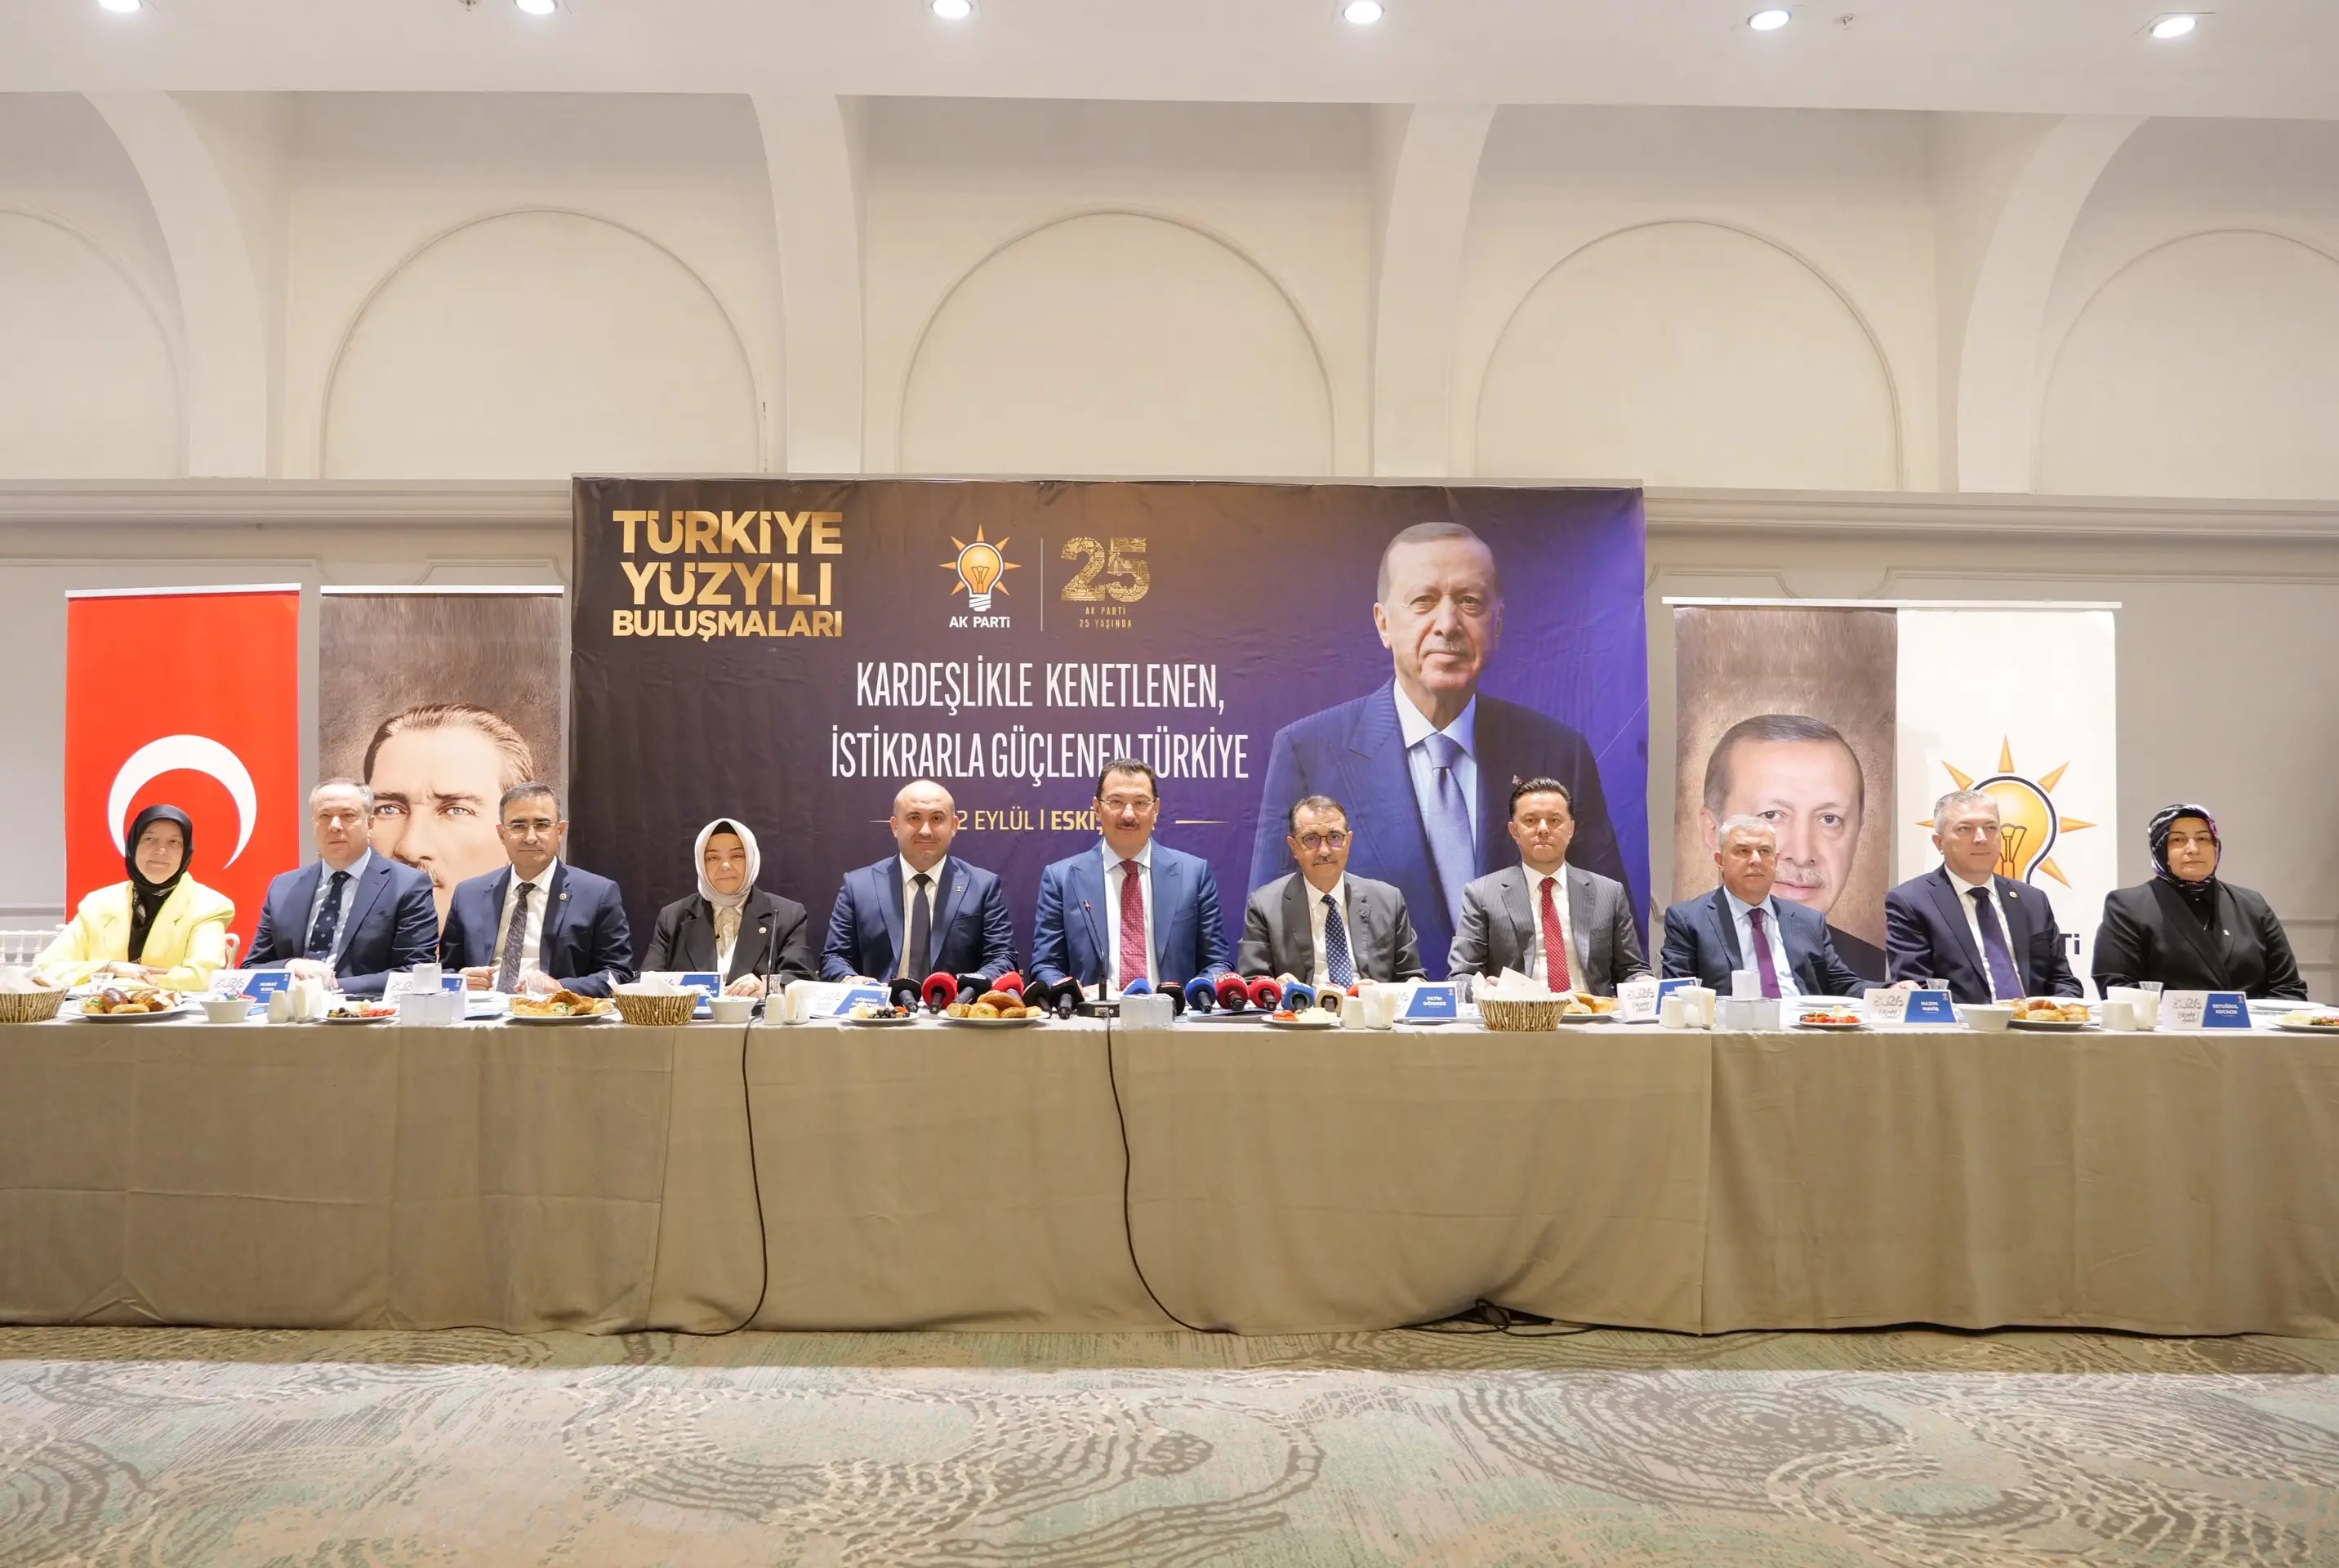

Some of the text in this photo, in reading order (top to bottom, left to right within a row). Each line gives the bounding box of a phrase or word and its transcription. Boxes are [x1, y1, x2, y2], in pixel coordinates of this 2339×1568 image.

[613, 510, 842, 555] TÜRKİYE
[620, 562, 831, 606] YÜZYILI
[1060, 537, 1151, 603] 25
[613, 610, 842, 642] BULUŞMALARI
[949, 616, 968, 628] AK
[1079, 618, 1132, 630] 25 YAŞINDA
[1085, 604, 1126, 616] AK PARTİ
[857, 655, 1225, 715] KARDEŞLİKLE KENETLENEN,
[831, 724, 985, 778] İSTİKRARLA
[1138, 726, 1249, 778] TÜRKİYE
[975, 805, 1033, 831] EYLÜL
